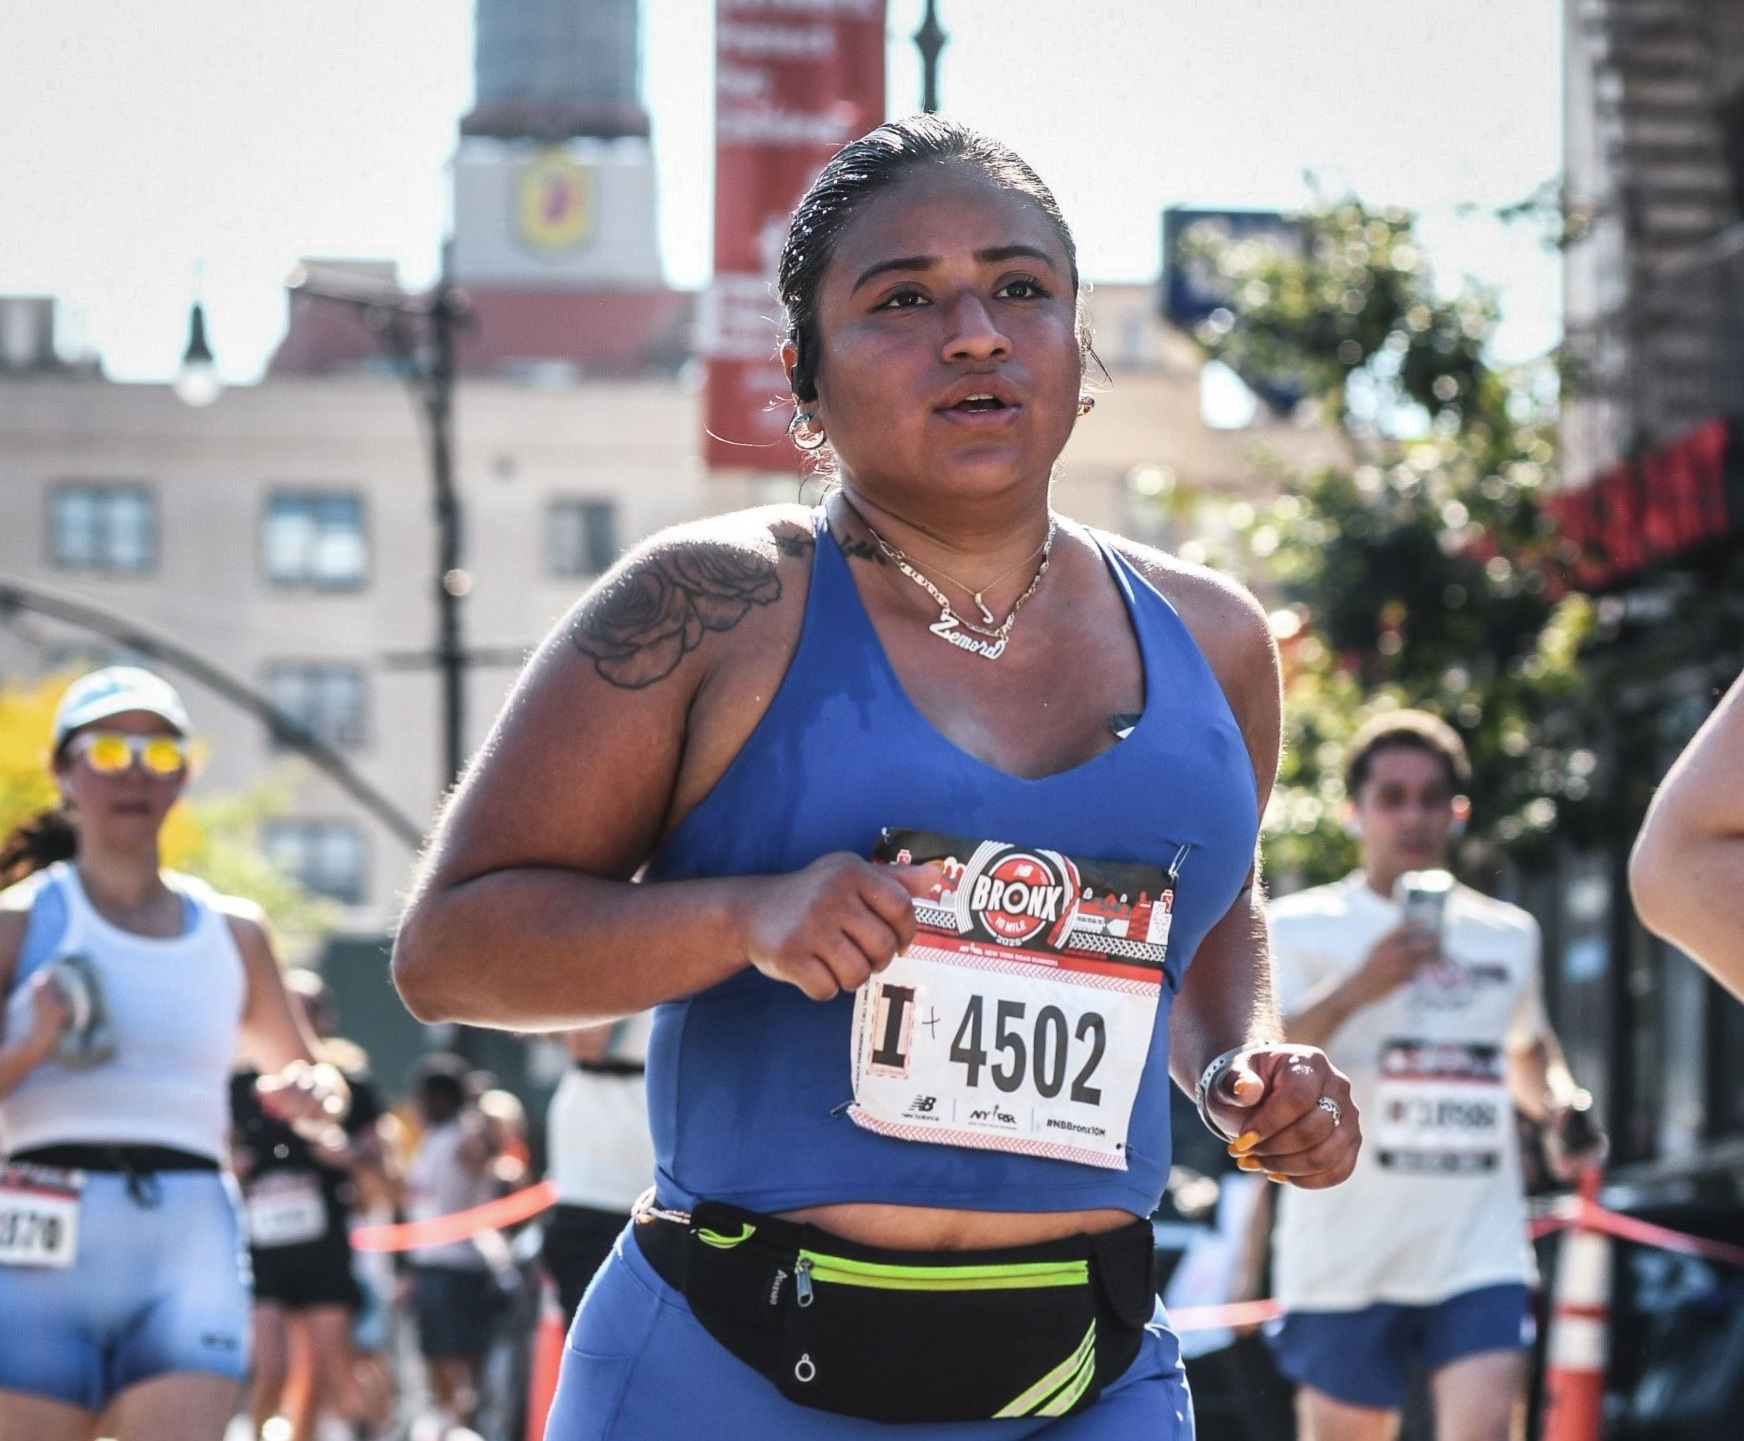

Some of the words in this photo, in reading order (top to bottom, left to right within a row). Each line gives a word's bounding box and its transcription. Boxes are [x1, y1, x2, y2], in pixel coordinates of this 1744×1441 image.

[971, 874, 1063, 922] BRONX
[995, 916, 1006, 930] 10
[1004, 919, 1027, 933] MILE
[872, 984, 915, 1068] I
[949, 994, 1106, 1107] 4502
